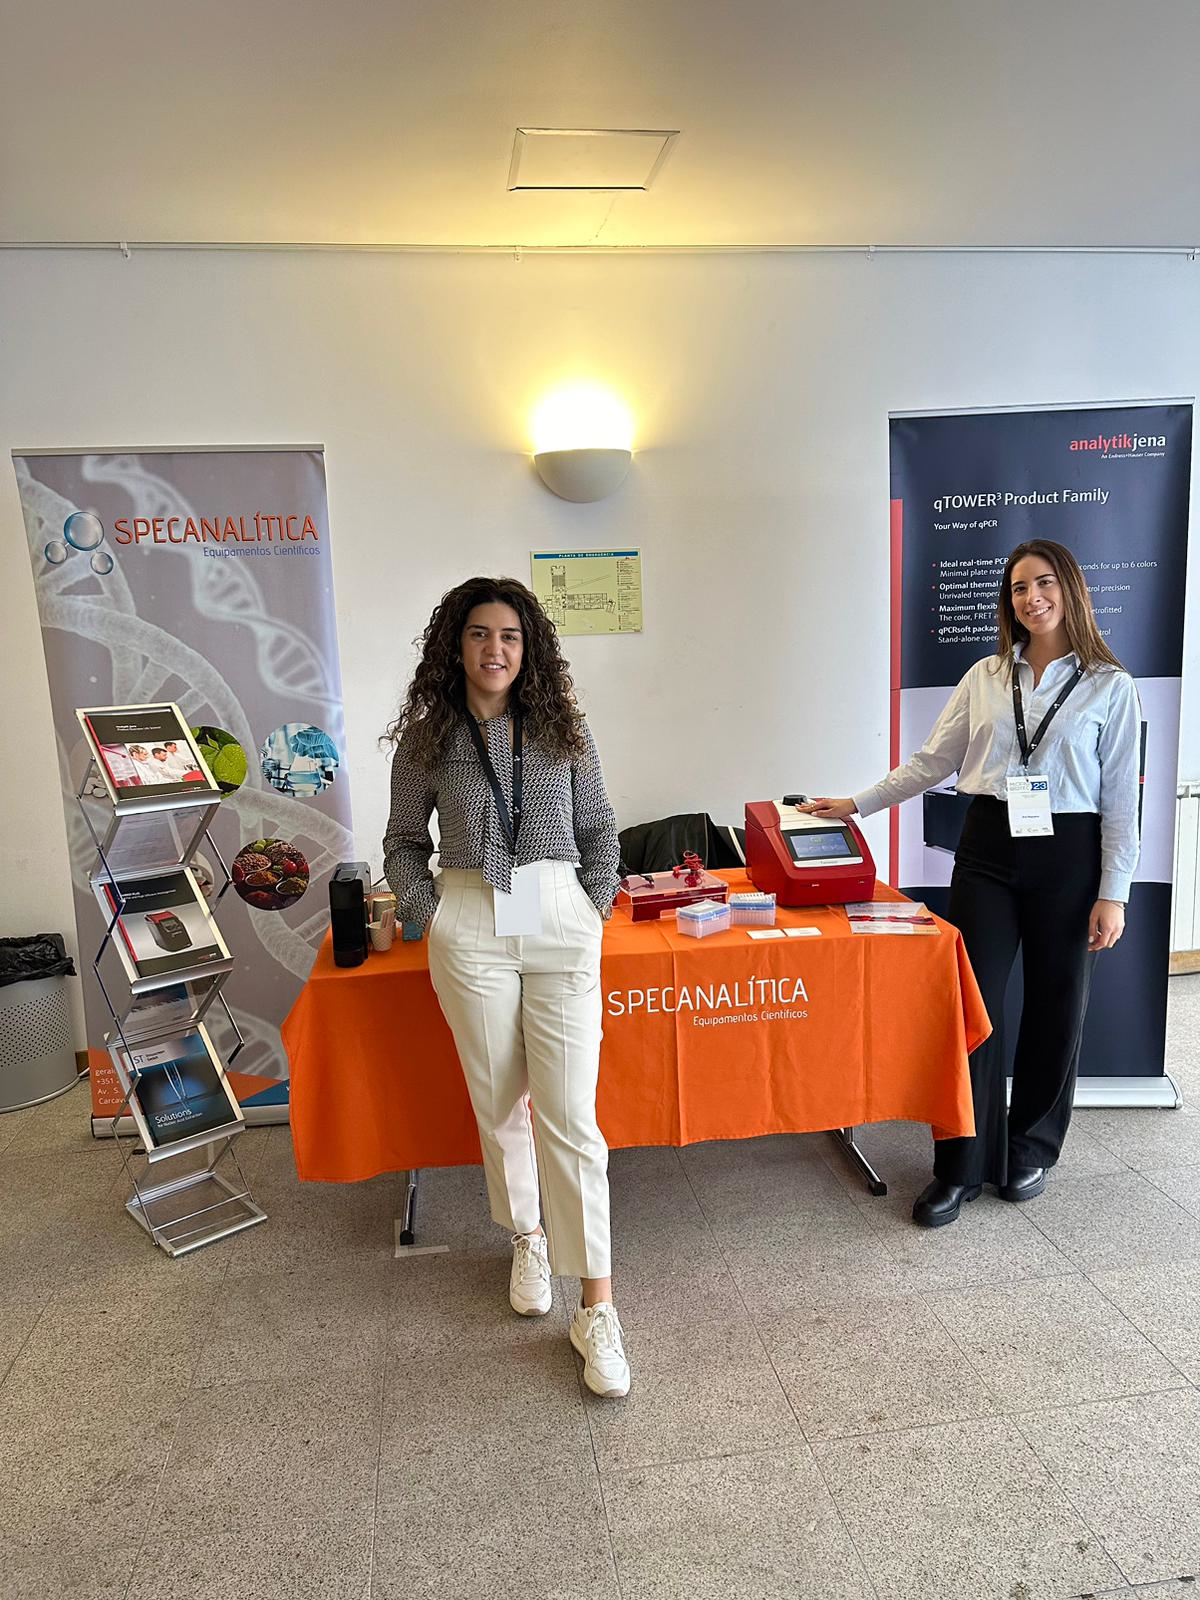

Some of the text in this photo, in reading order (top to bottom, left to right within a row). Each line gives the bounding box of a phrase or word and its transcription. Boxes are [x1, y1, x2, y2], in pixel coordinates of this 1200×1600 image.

[1069, 433, 1166, 453] analytikjena
[1004, 491, 1059, 506] Product
[1062, 488, 1110, 505] Family
[114, 511, 319, 545] SPECANALÍTICA
[934, 520, 998, 531] Your Way of qPCR
[203, 545, 321, 559] Equipamentos Científicos
[940, 560, 958, 568] Ideal
[959, 558, 993, 567] real-time
[1079, 562, 1099, 571] conds
[1111, 562, 1121, 570] up
[1130, 560, 1136, 568] 6
[940, 569, 969, 577] Minimal
[970, 568, 988, 578] plate
[939, 581, 969, 591] Optimal
[970, 580, 999, 588] thermal
[1101, 584, 1131, 593] precision
[939, 591, 972, 600] Unrivaled
[939, 603, 998, 612] Maximum flexib
[1090, 606, 1122, 614] etrofitted
[939, 614, 953, 622] The
[953, 613, 973, 621] color,
[974, 612, 992, 620] FRET
[938, 626, 971, 635] qPCRsoft
[1099, 628, 1111, 636] trol
[938, 635, 980, 644] Stand-alone
[1032, 782, 1047, 790] 23
[607, 975, 809, 1016] SPECANALÍTICA
[693, 1009, 808, 1027] Equipamentos Científicos
[133, 1054, 144, 1064] ST
[95, 1068, 116, 1077] geral
[155, 1109, 192, 1124] Solutions
